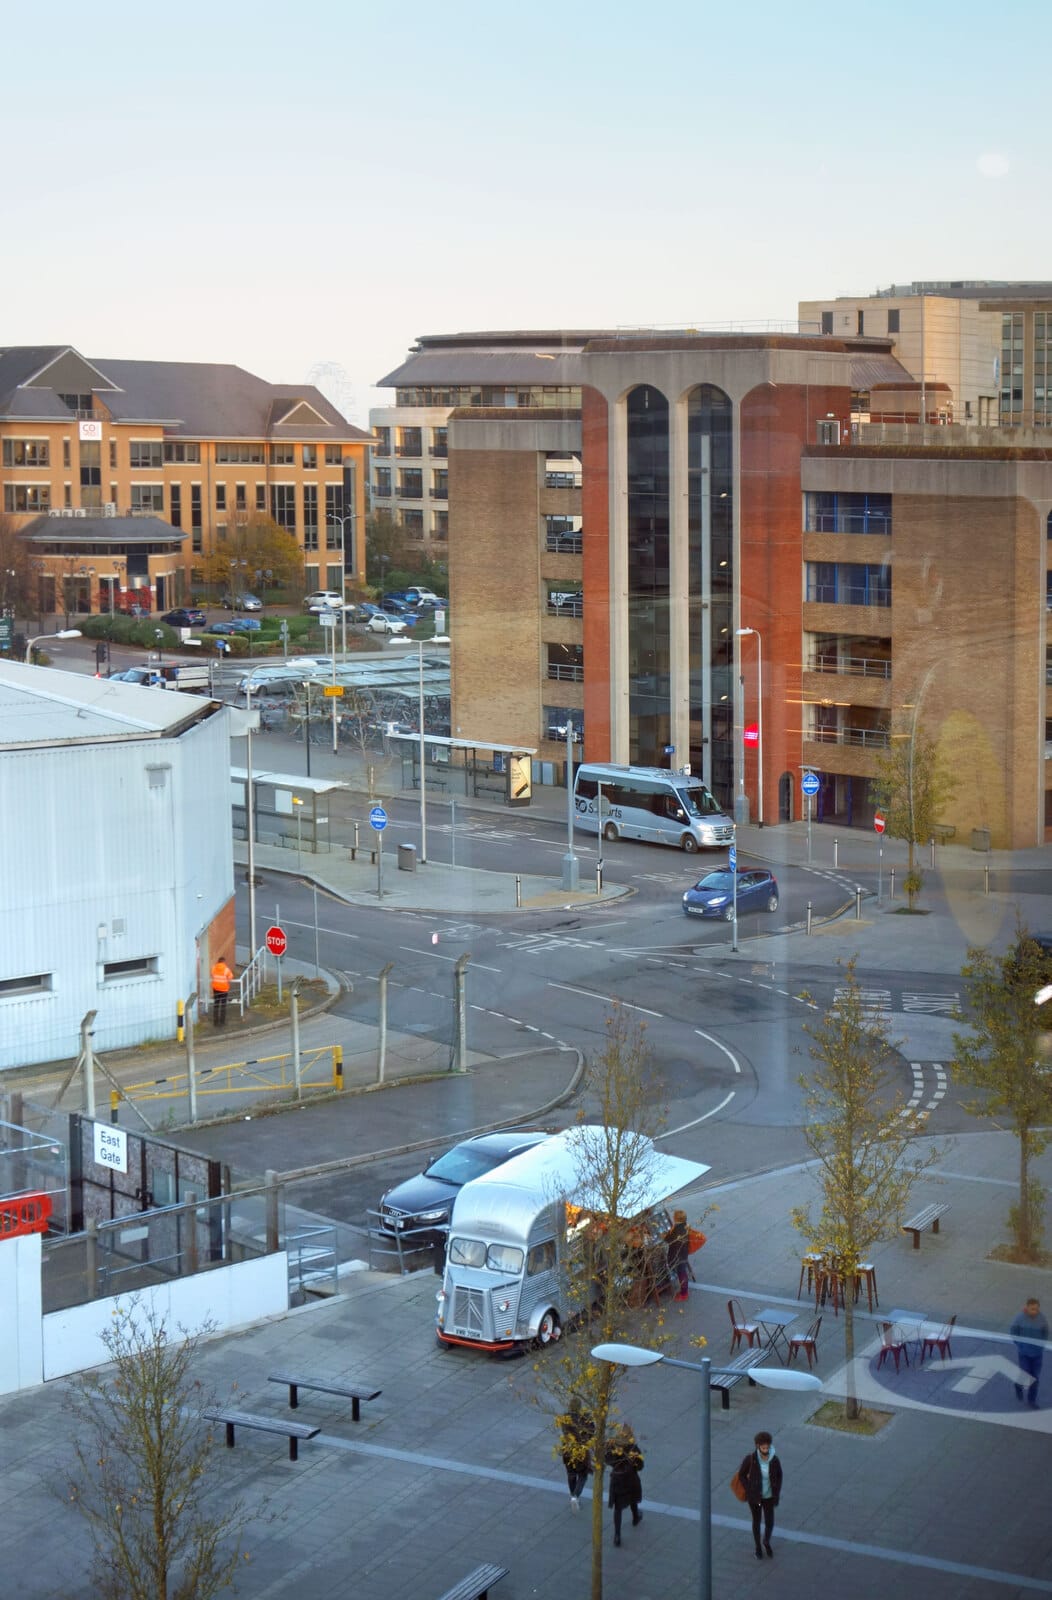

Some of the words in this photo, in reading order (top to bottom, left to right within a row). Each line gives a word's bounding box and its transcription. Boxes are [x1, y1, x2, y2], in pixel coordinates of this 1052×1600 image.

[267, 936, 285, 946] STOP
[100, 1130, 121, 1148] East
[100, 1147, 121, 1165] Gate
